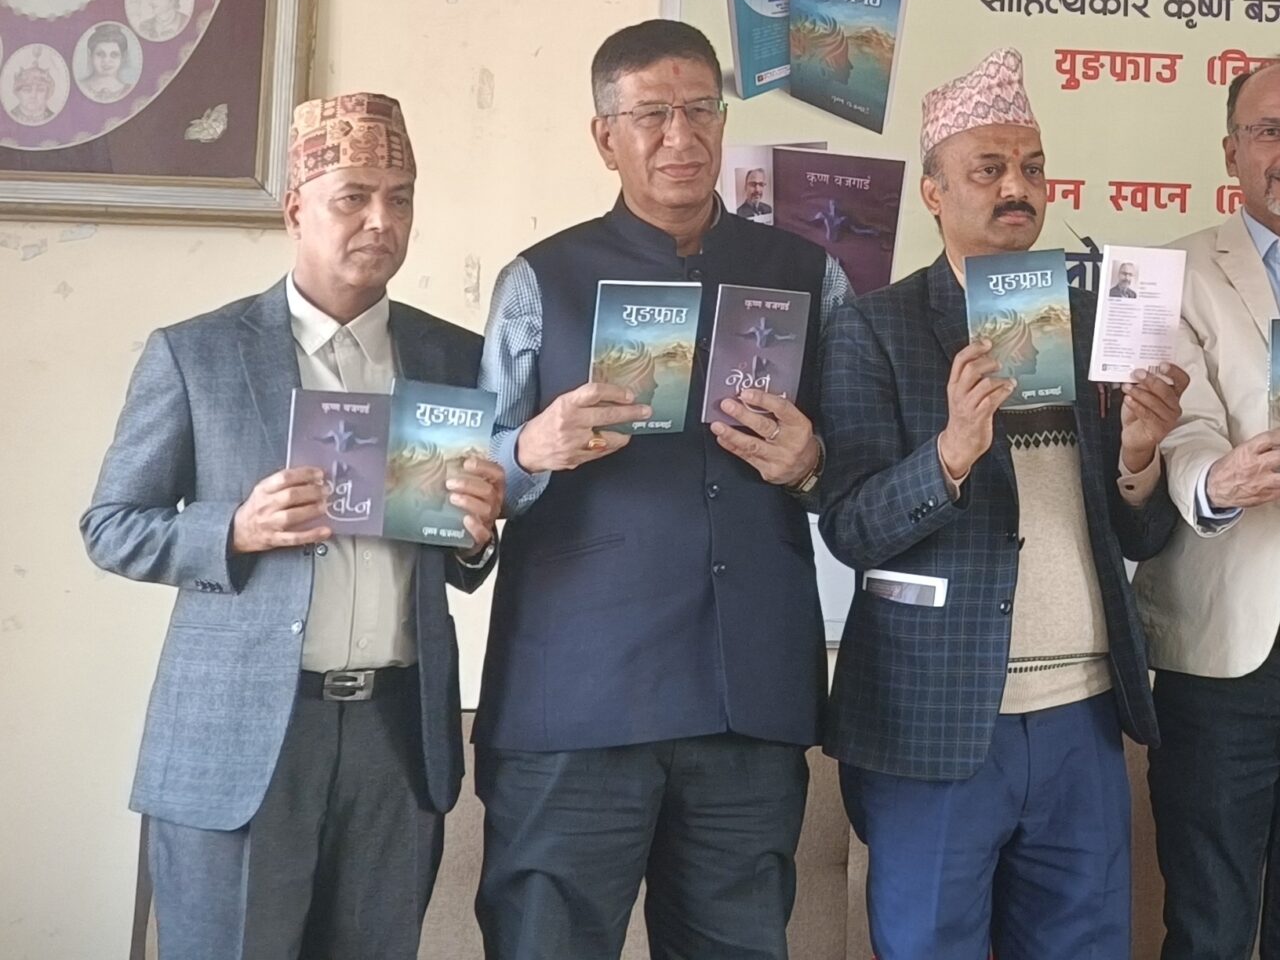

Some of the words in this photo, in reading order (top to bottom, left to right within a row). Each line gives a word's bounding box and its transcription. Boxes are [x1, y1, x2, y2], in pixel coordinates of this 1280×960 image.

[1055, 49, 1183, 90] युङफ्राउ
[806, 171, 829, 187] कृष्ण
[1108, 181, 1191, 213] स्वप्न
